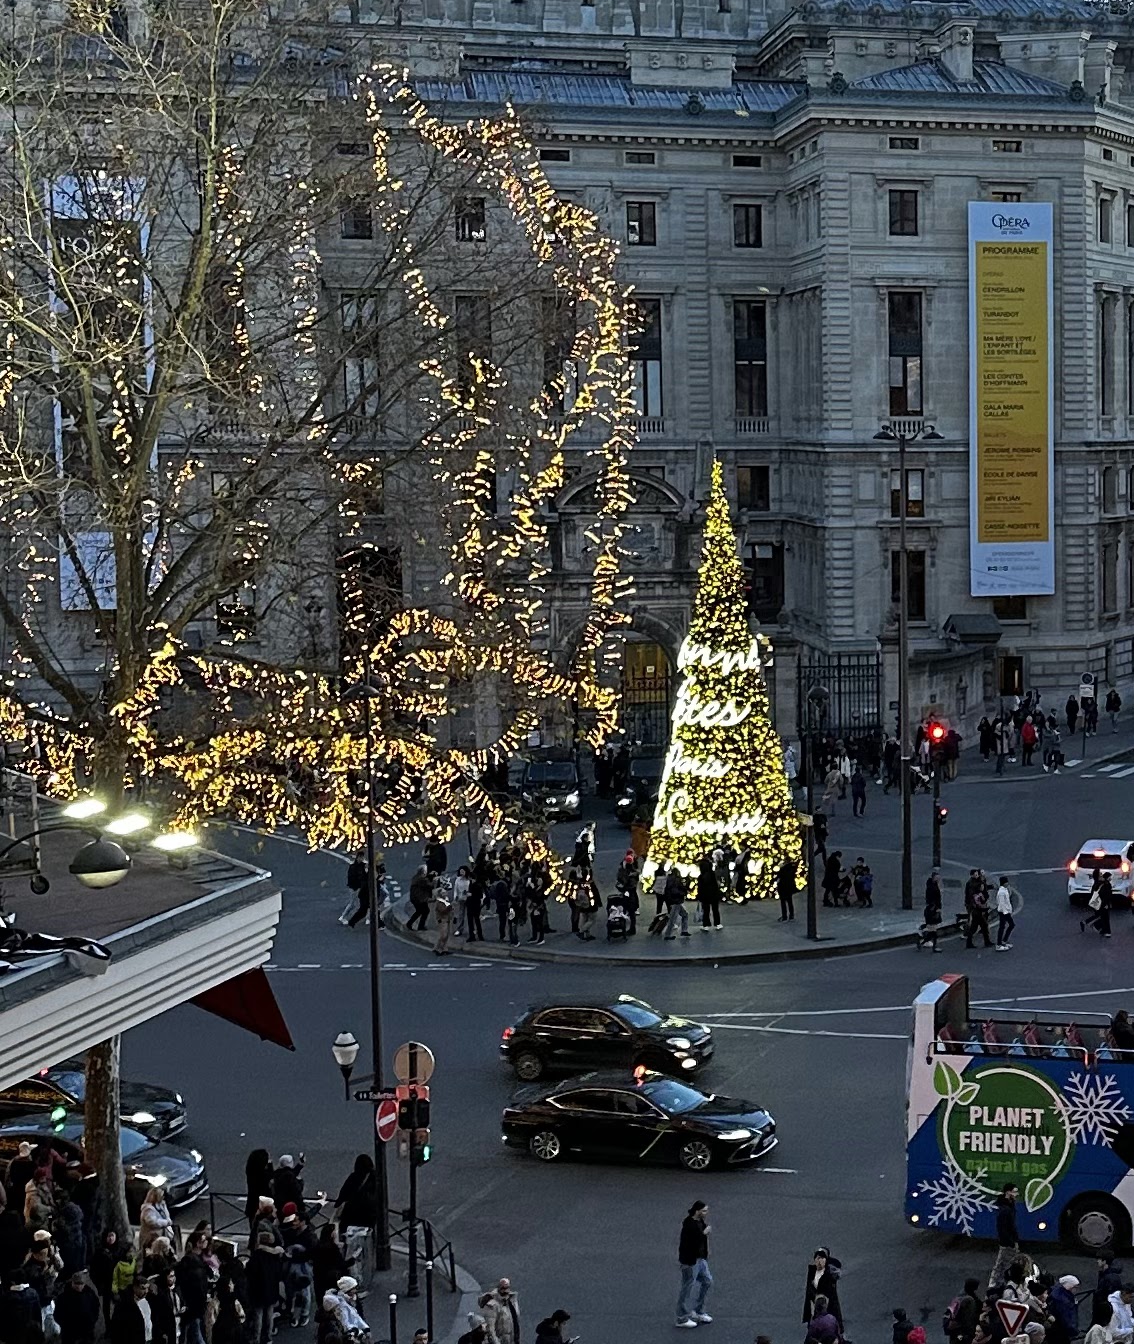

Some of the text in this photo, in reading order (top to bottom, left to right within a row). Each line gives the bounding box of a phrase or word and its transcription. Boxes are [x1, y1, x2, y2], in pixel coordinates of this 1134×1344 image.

[969, 1105, 1045, 1129] PLANET
[959, 1131, 1055, 1156] FRIENDLY
[966, 1157, 1047, 1176] natural gas
